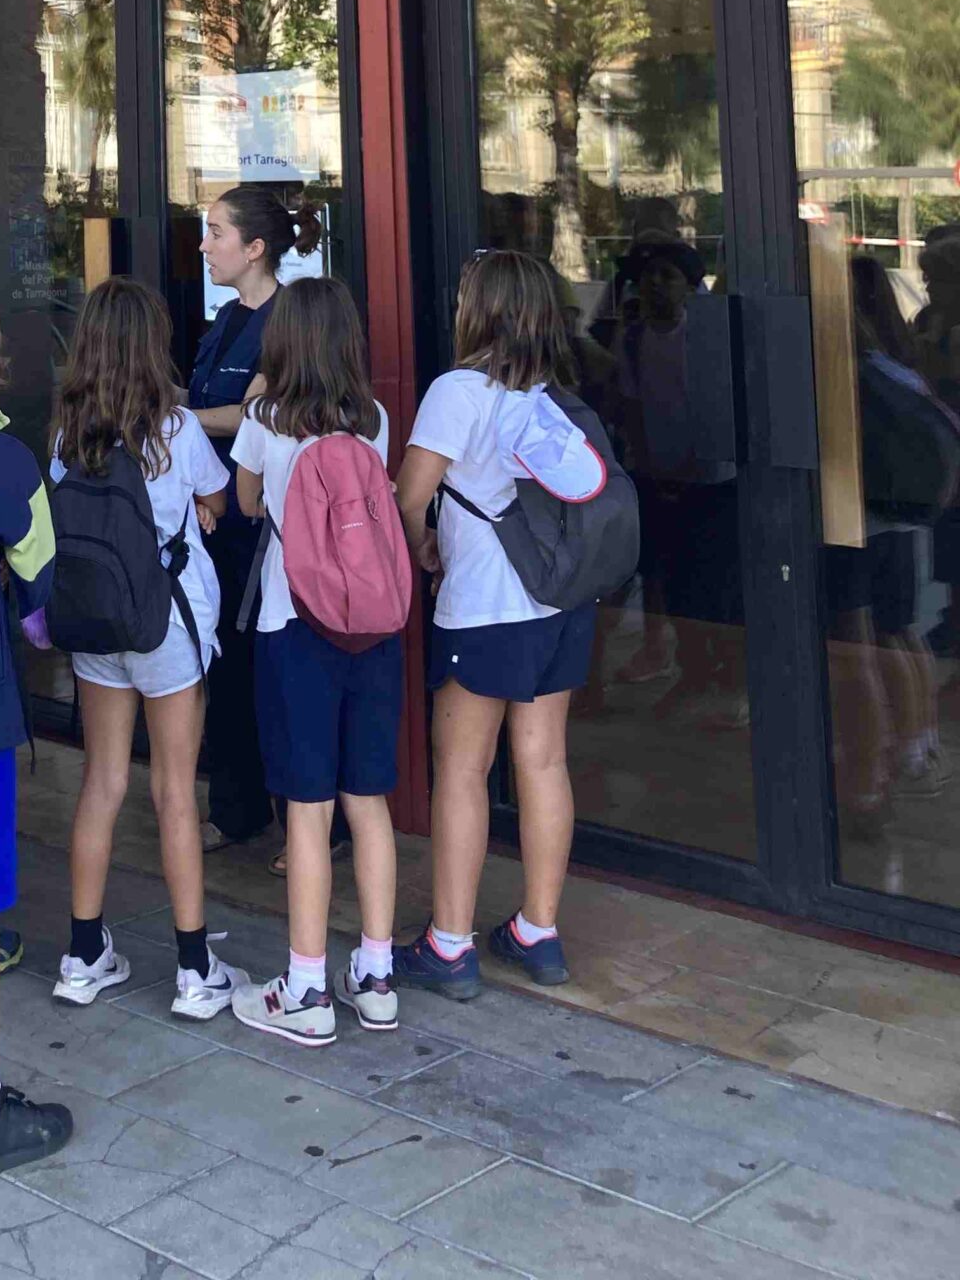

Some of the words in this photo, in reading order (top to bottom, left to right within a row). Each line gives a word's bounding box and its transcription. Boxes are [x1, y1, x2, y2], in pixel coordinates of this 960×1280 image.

[253, 153, 308, 168] Tarragona
[11, 289, 23, 299] de
[25, 288, 67, 300] Tarragona
